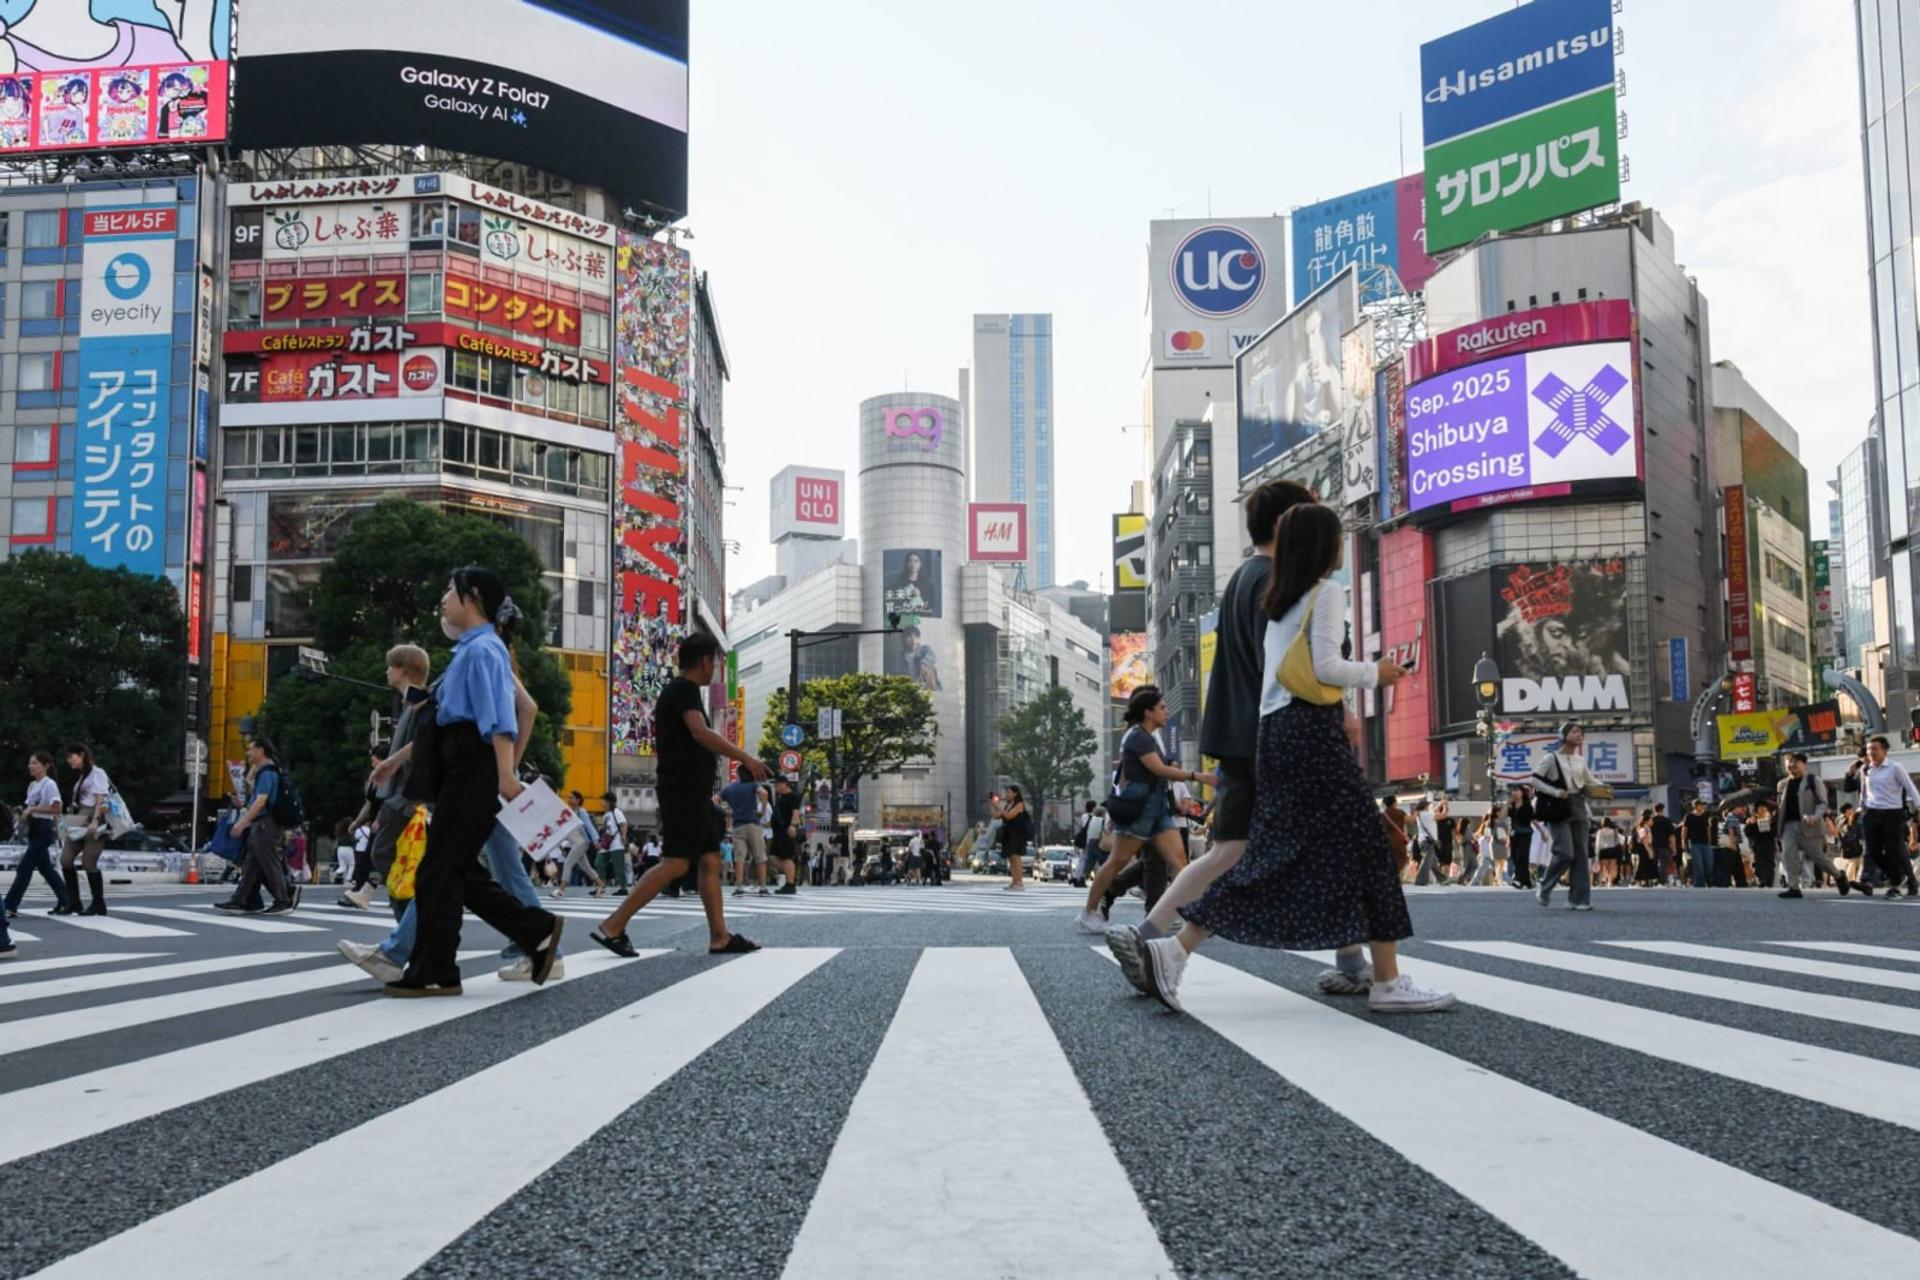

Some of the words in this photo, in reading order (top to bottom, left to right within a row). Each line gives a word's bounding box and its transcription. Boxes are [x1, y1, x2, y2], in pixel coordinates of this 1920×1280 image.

[1424, 26, 1609, 102] Hisamitsu
[400, 66, 479, 95] Galaxy
[482, 78, 495, 96] Z
[498, 81, 550, 109] Fold7
[424, 94, 489, 120] Galaxy
[492, 105, 508, 121] AI
[1436, 126, 1606, 216] サロンパス
[250, 177, 400, 201] しゃぶしゃぶバイキング
[93, 211, 168, 232] 当ビル5F
[314, 211, 400, 242] しゃぶ葉
[471, 183, 610, 239] しゃぶしゃぶバイキング
[235, 225, 260, 243] 9F
[1315, 211, 1376, 254] 龍角散
[527, 233, 606, 281] しゃぶ葉
[267, 279, 401, 312] プライス
[446, 280, 577, 334] コンタクト
[91, 303, 161, 327] eyecity
[350, 325, 416, 351] ガスト
[1457, 318, 1547, 353] Rakuten
[228, 371, 260, 392] 7F
[267, 368, 304, 385] Café
[307, 362, 391, 398] ガスト
[540, 349, 599, 382] ガスト
[1411, 415, 1509, 457] Shibuya
[84, 370, 126, 553] アイシティ
[126, 370, 158, 552] コンタクトの
[1412, 452, 1525, 495] Crossing
[801, 482, 831, 501] UNI
[800, 500, 834, 519] QLO
[1502, 674, 1630, 713] DMM
